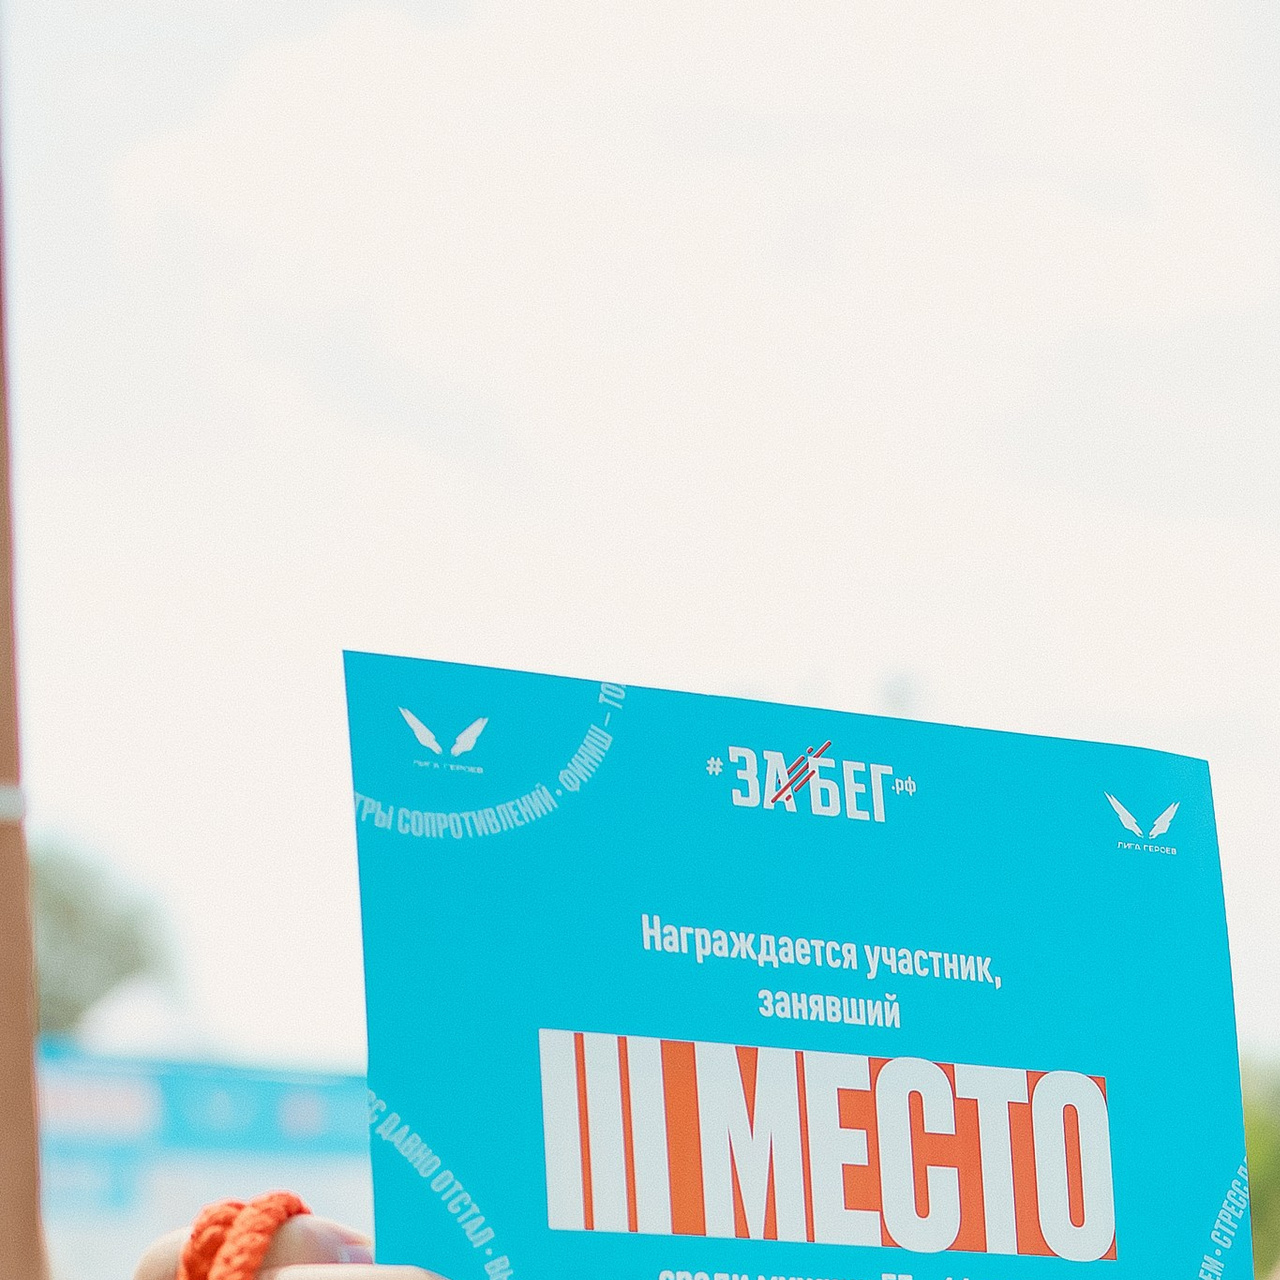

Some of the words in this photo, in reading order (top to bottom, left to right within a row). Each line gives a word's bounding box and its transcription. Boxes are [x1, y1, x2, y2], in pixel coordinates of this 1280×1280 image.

[397, 782, 559, 839] СОПРОТИВЛЕНИЙ
[558, 723, 613, 793] ФИНИШ
[1117, 841, 1141, 851] ЛИГА
[1143, 844, 1177, 855] ГЕРОЕВ
[640, 914, 858, 968] Награждается
[864, 944, 1003, 989] участник,
[757, 988, 901, 1029] занявший
[377, 1112, 442, 1179] ДАВНО
[430, 1170, 496, 1249] ОТСТАЛ
[694, 1041, 1117, 1262] МЕСТО
[1211, 1178, 1249, 1250] СТРЕСС
